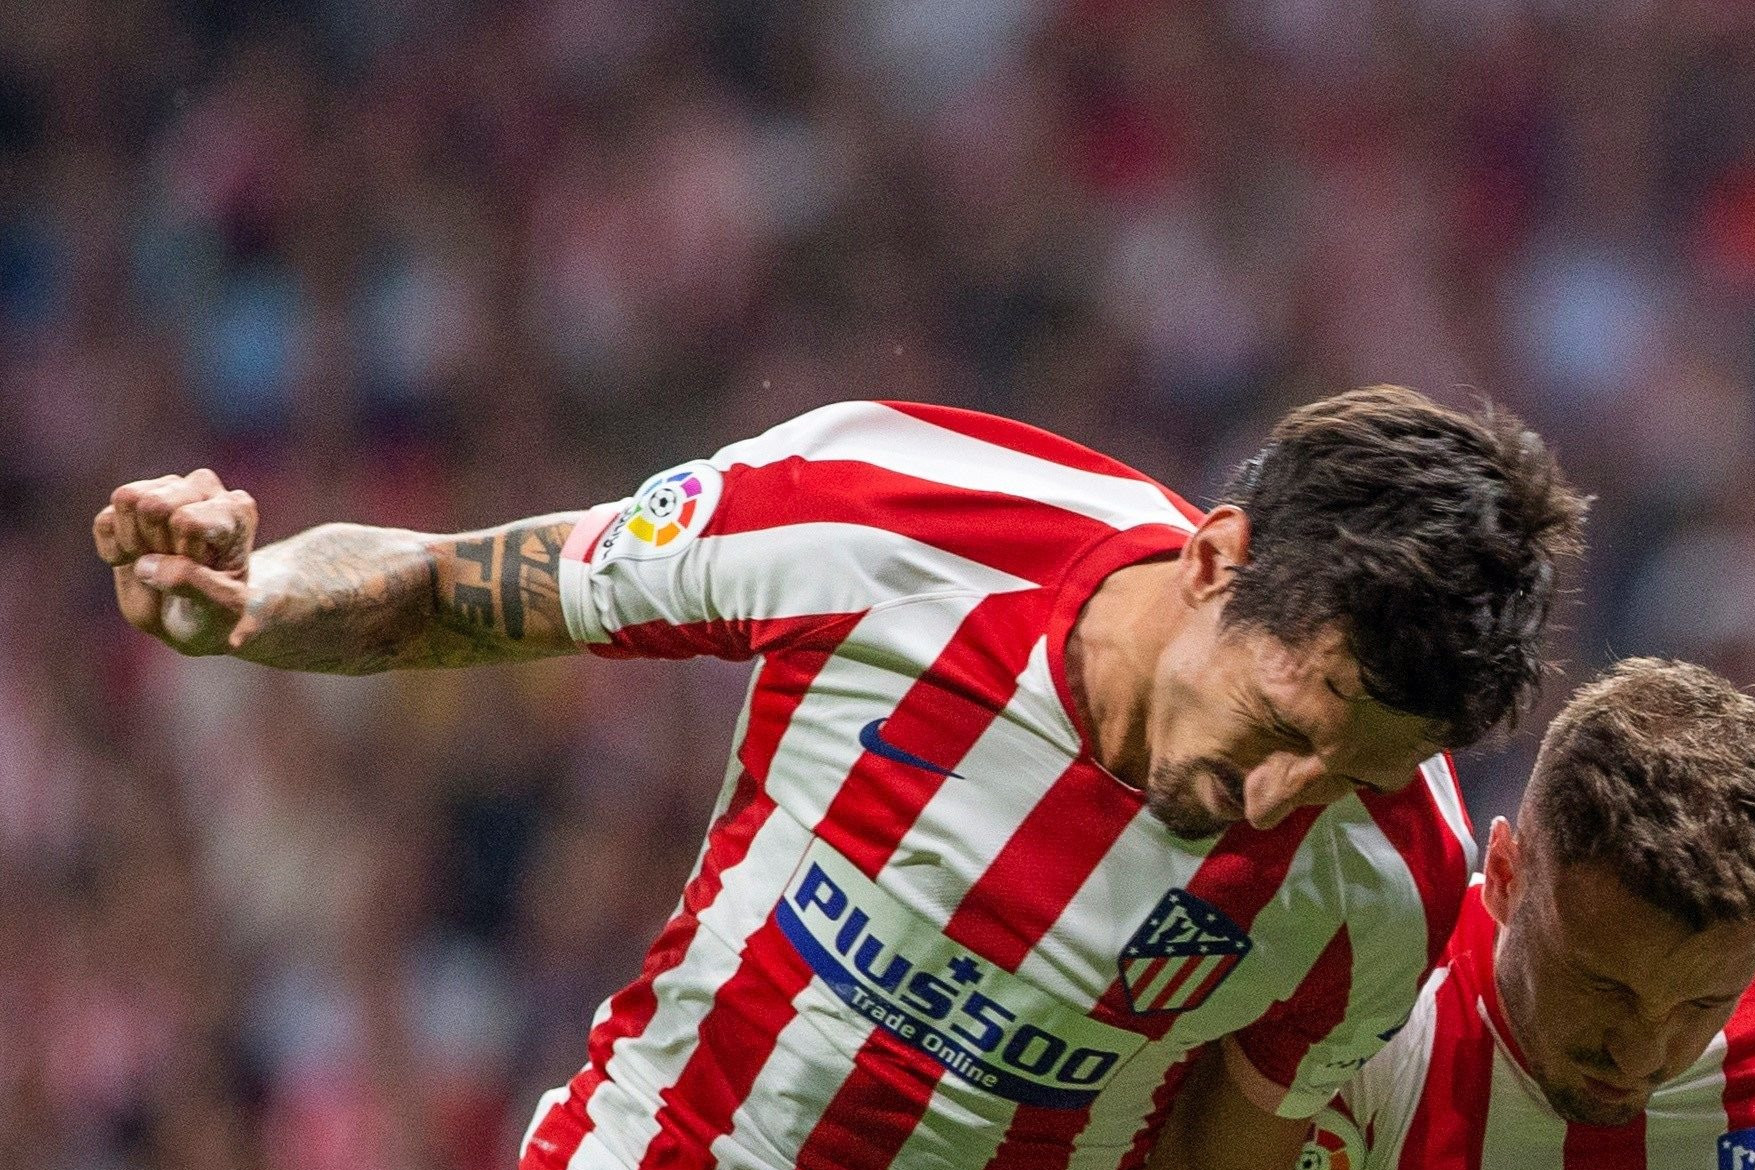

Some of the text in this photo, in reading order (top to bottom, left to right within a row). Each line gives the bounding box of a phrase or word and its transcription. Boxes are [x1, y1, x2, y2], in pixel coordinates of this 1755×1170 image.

[794, 861, 1120, 1085] Plus500
[852, 985, 999, 1088] Trade Online
